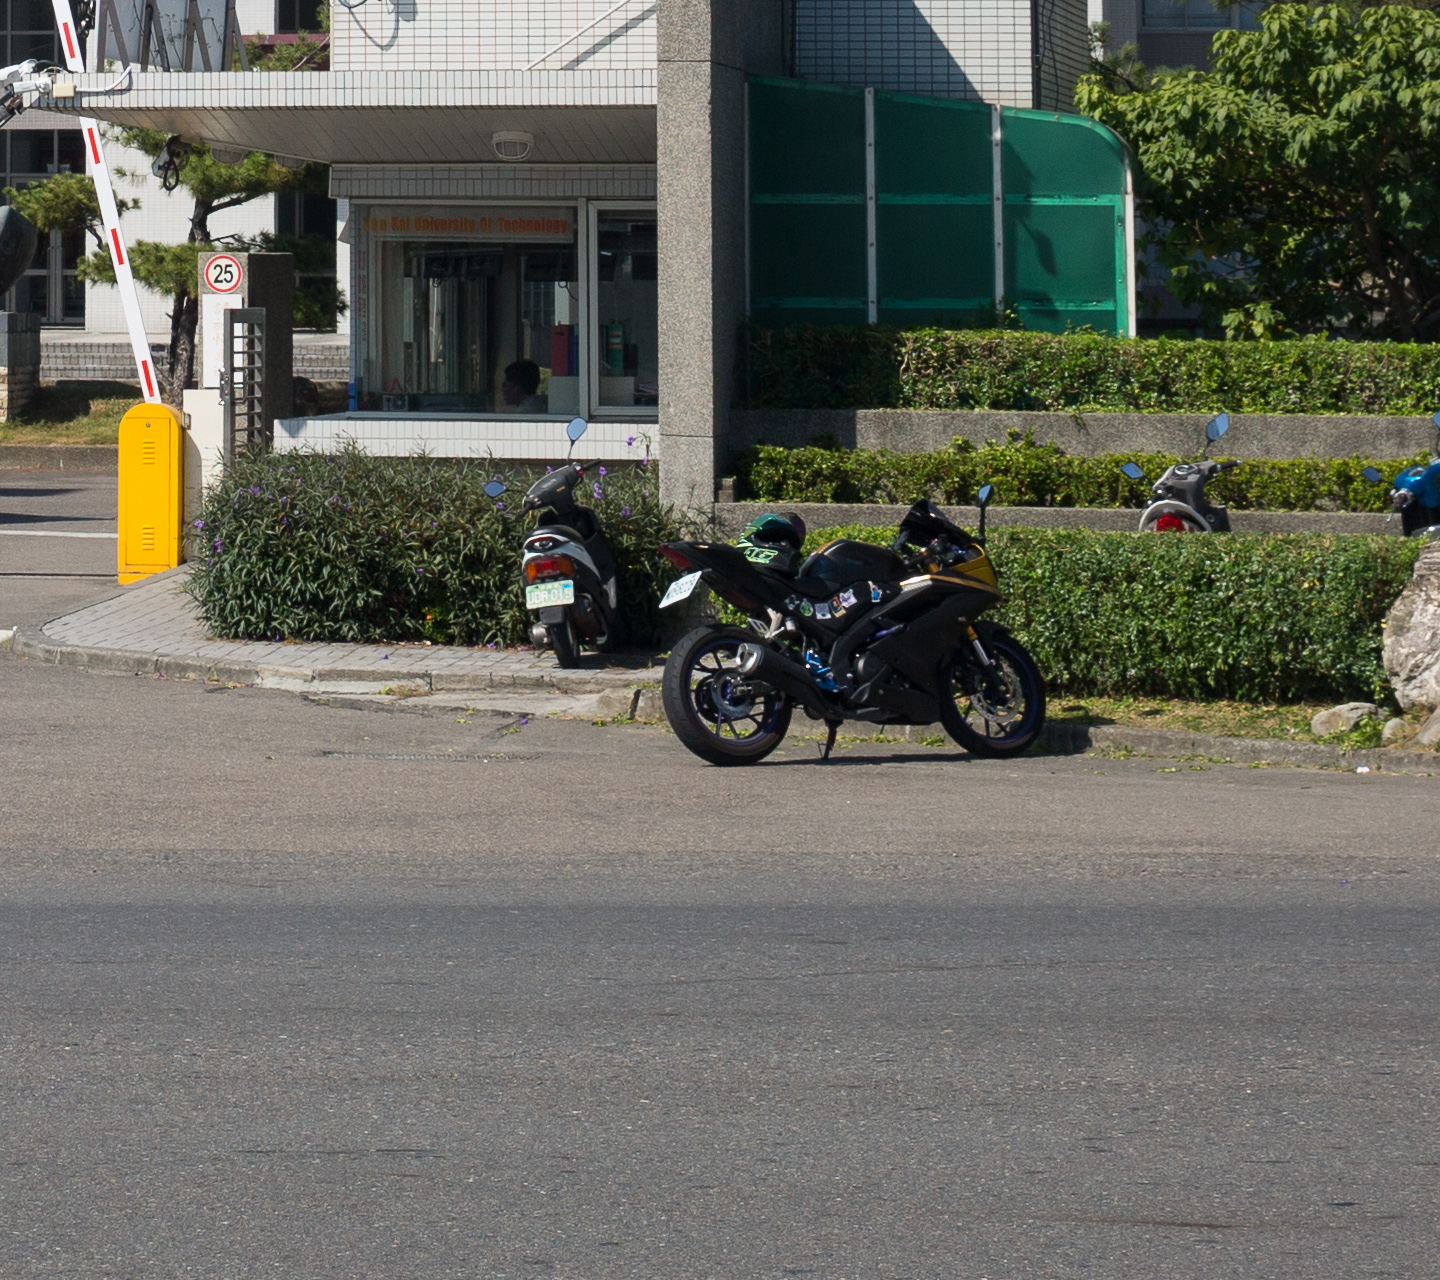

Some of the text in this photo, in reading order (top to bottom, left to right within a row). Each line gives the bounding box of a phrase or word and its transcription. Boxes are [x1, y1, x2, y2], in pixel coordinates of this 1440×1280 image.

[415, 216, 475, 233] University
[498, 216, 567, 234] Technology
[213, 263, 234, 284] 25
